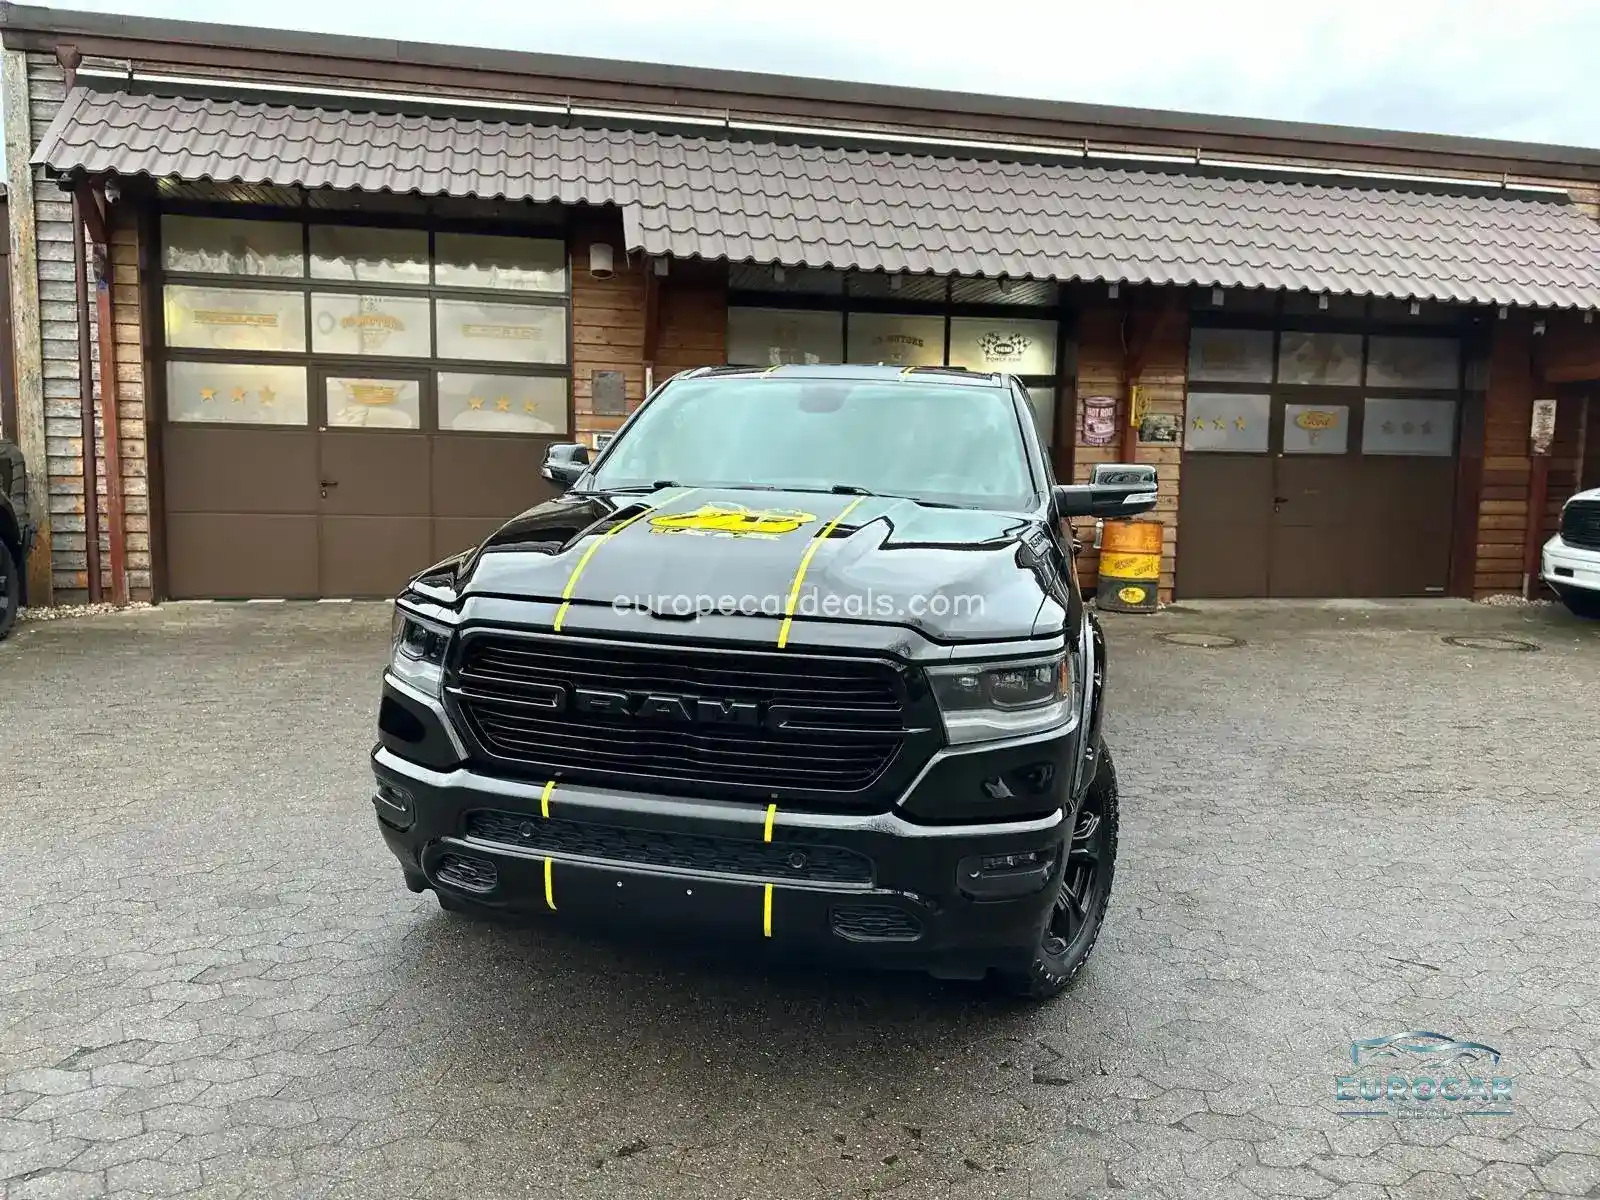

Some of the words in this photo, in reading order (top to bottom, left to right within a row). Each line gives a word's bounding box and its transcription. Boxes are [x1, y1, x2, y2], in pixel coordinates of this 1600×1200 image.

[1087, 407, 1100, 417] HOT
[1100, 407, 1113, 417] ROD
[574, 688, 760, 725] RAM
